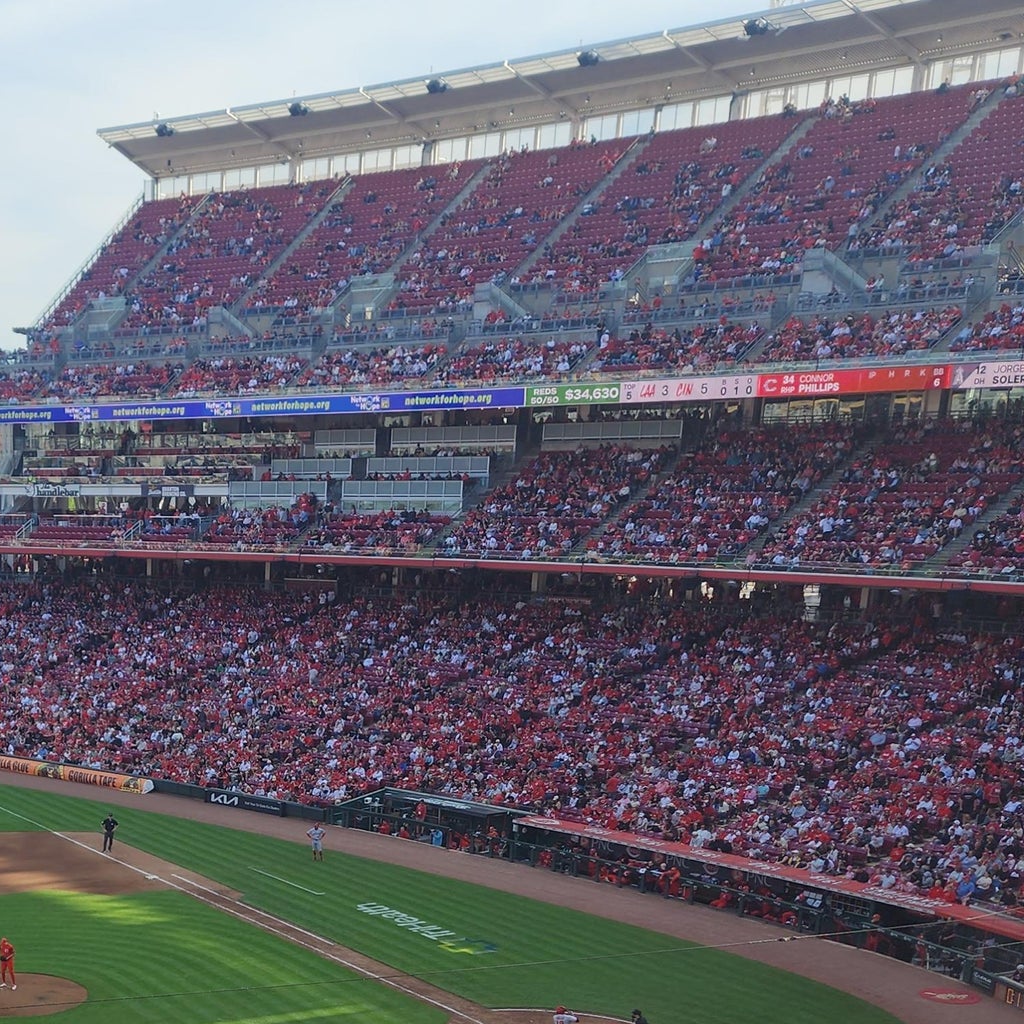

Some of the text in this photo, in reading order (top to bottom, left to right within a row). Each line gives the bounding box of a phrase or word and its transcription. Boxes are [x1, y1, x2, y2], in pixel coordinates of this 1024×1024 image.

[933, 368, 944, 376] BB
[976, 366, 986, 374] 12
[782, 373, 834, 385] 34 CONNOR
[933, 378, 941, 387] 6
[533, 387, 558, 396] REDS
[564, 387, 619, 401] $34,630
[640, 384, 708, 398] LAA 3 CIN 5
[720, 385, 752, 396] 0 1 0
[798, 383, 839, 393] PHILLIPS
[404, 393, 492, 407] networkforhope.org
[530, 395, 559, 405] 50/50
[626, 391, 632, 400] 5
[113, 406, 185, 417] networkforhope.org
[251, 400, 330, 412] networkforhope.org
[36, 485, 80, 496] handlebar
[12, 761, 29, 773] GLUE
[68, 769, 117, 787] GORILLA TAPE
[211, 793, 239, 806] KIA
[591, 838, 615, 853] PNC
[666, 855, 690, 869] PNC
[746, 872, 772, 887] PNC
[356, 902, 456, 941] TriHealth
